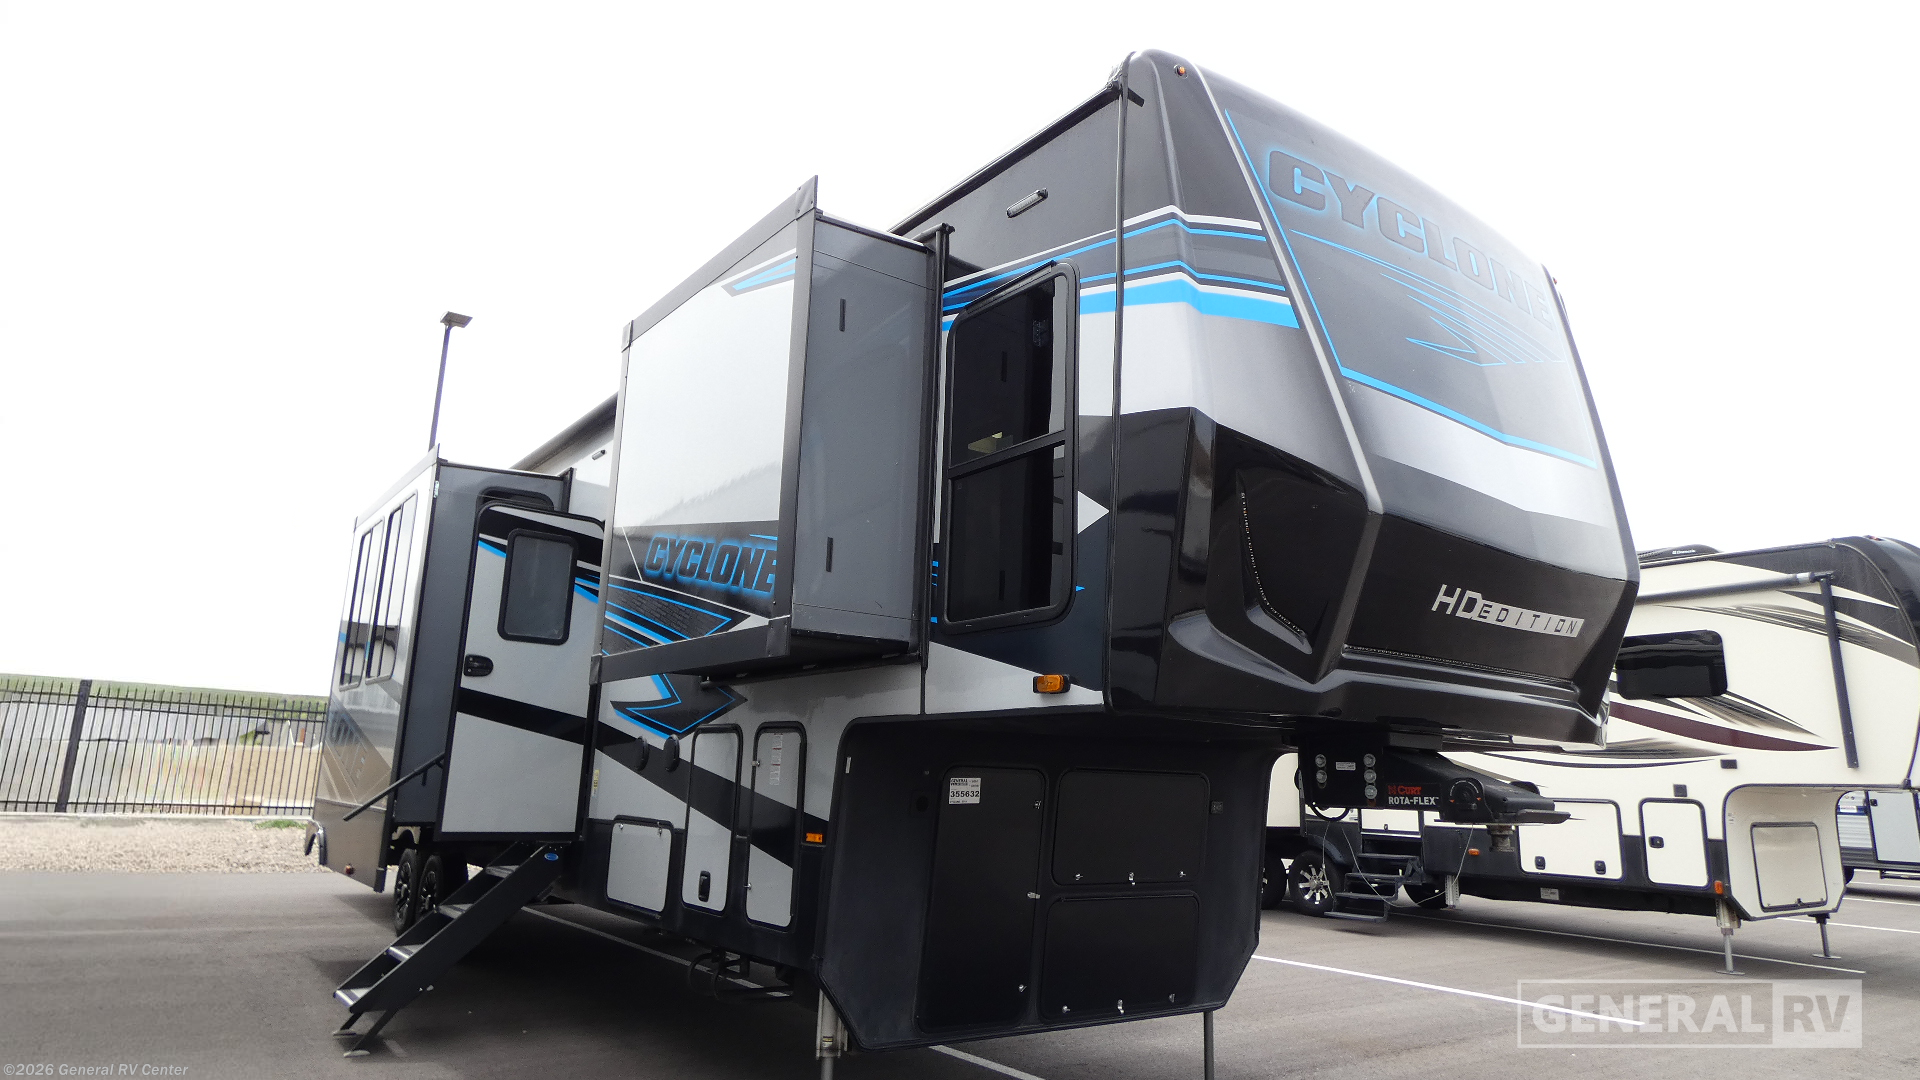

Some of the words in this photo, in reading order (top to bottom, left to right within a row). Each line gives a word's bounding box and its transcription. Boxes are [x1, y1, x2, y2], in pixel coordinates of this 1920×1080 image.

[1268, 150, 1554, 331] CYCLONE
[645, 535, 777, 594] CYCLONE
[950, 790, 980, 798] 355632
